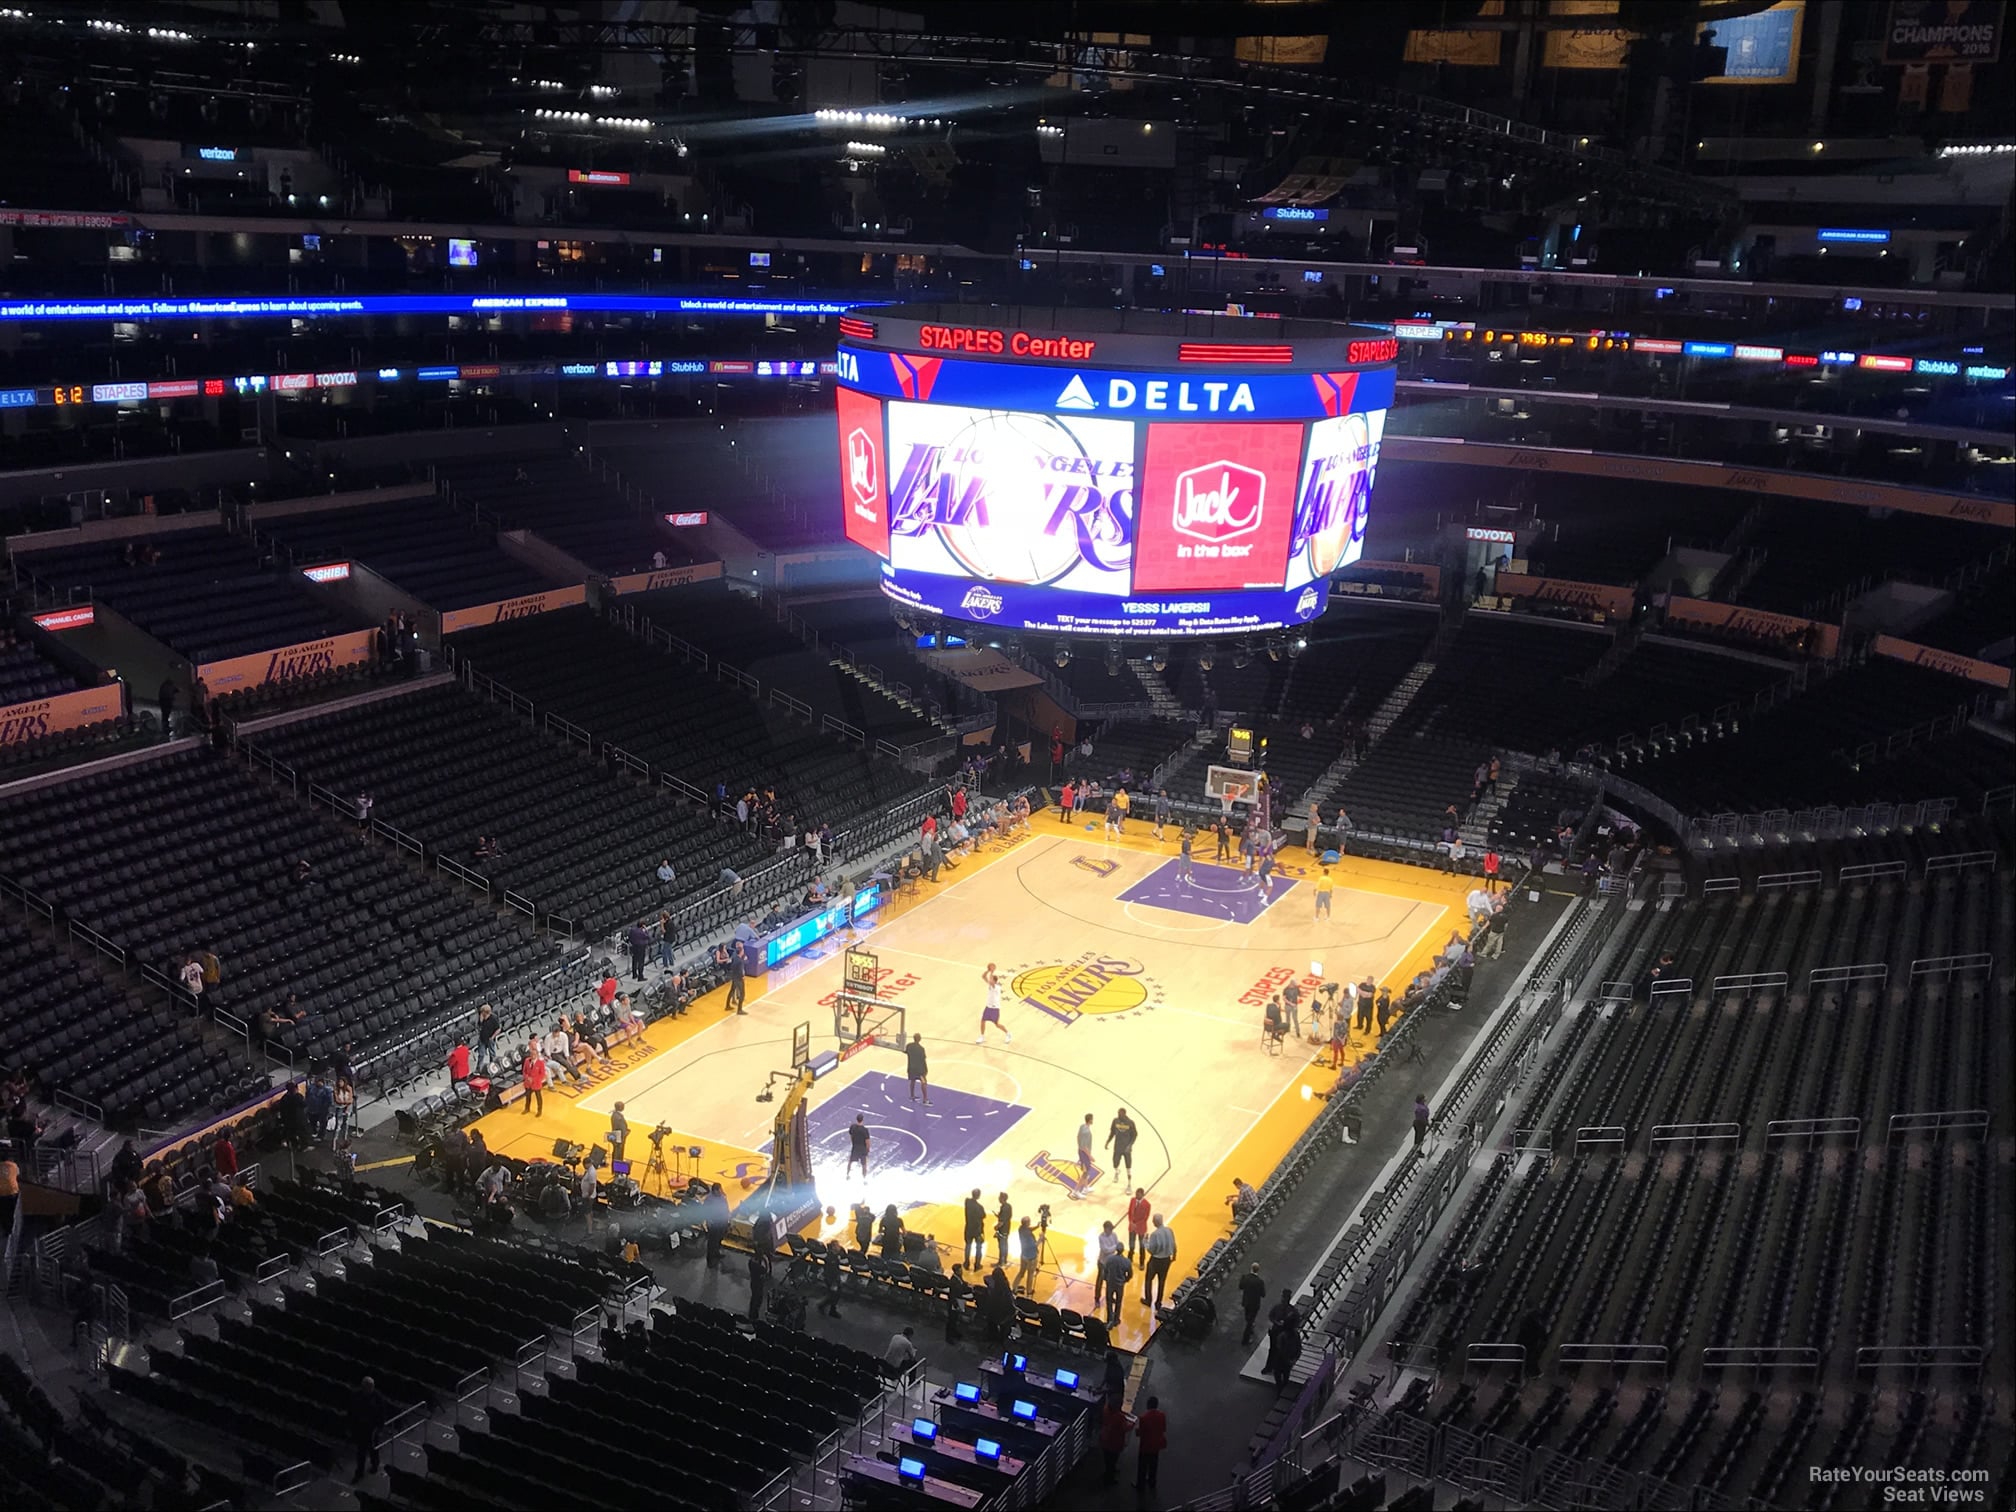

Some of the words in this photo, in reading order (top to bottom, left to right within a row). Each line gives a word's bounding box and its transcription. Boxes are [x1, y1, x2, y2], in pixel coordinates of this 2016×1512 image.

[1892, 24, 1995, 44] CHAMPIONS
[1961, 43, 1991, 55] 2016
[199, 146, 235, 160] verizon
[1276, 207, 1316, 220] StubHub
[8, 304, 34, 316] world
[35, 304, 45, 315] of
[45, 303, 106, 316] entertainment
[107, 303, 124, 314] and
[124, 303, 153, 316] sports.
[153, 302, 178, 313] Follow
[178, 304, 188, 313] us
[261, 301, 269, 311] to
[269, 301, 287, 311] learn
[288, 300, 307, 311] about
[308, 300, 340, 312] upcoming
[472, 298, 524, 307] AMERICAN
[525, 298, 568, 307] EXPRESS
[680, 300, 702, 310] Unlock
[708, 301, 727, 311] world
[727, 301, 735, 311] of
[735, 302, 782, 312] entertainment
[782, 303, 796, 312] and
[1397, 325, 1442, 338] STAPLES
[919, 325, 1004, 354] STAPLES
[1012, 332, 1096, 359] Center
[1350, 341, 1390, 363] STAPLES
[1736, 346, 1782, 359] TOSHIBA
[562, 363, 596, 375] verizon
[671, 362, 705, 373] StubHub
[1918, 360, 1958, 374] StubHub
[1966, 365, 2006, 379] verizon
[316, 372, 357, 386] TOYOTA
[54, 386, 83, 404] 6:12
[94, 384, 146, 400] STAPLES
[1108, 378, 1256, 412] DELTA
[1178, 471, 1258, 528] Jack
[1466, 527, 1515, 542] TOYOTA
[1176, 544, 1193, 558] in
[1193, 544, 1221, 558] the
[1221, 543, 1251, 558] box
[960, 591, 1004, 615] LAKERS
[1121, 602, 1161, 614] YESSS
[1024, 620, 1037, 629] The
[1037, 621, 1060, 631] Lakers
[1073, 624, 1100, 633] confirm
[1100, 625, 1123, 635] receipt
[1123, 626, 1132, 635] of
[1132, 628, 1150, 636] your
[1056, 614, 1075, 623] TEXT
[1075, 617, 1091, 626] your
[1091, 618, 1122, 627] message
[1122, 618, 1131, 626] to
[284, 649, 299, 657] LOS
[300, 640, 335, 652] ANGELES
[264, 649, 335, 685] LAKERS
[2, 702, 50, 718] ANGELES
[0, 712, 51, 746] ERS
[1036, 980, 1057, 995] LOS
[1056, 950, 1096, 984] ANGELES
[1019, 954, 1145, 1029] LAKERS
[1238, 966, 1296, 1008] STAPLES
